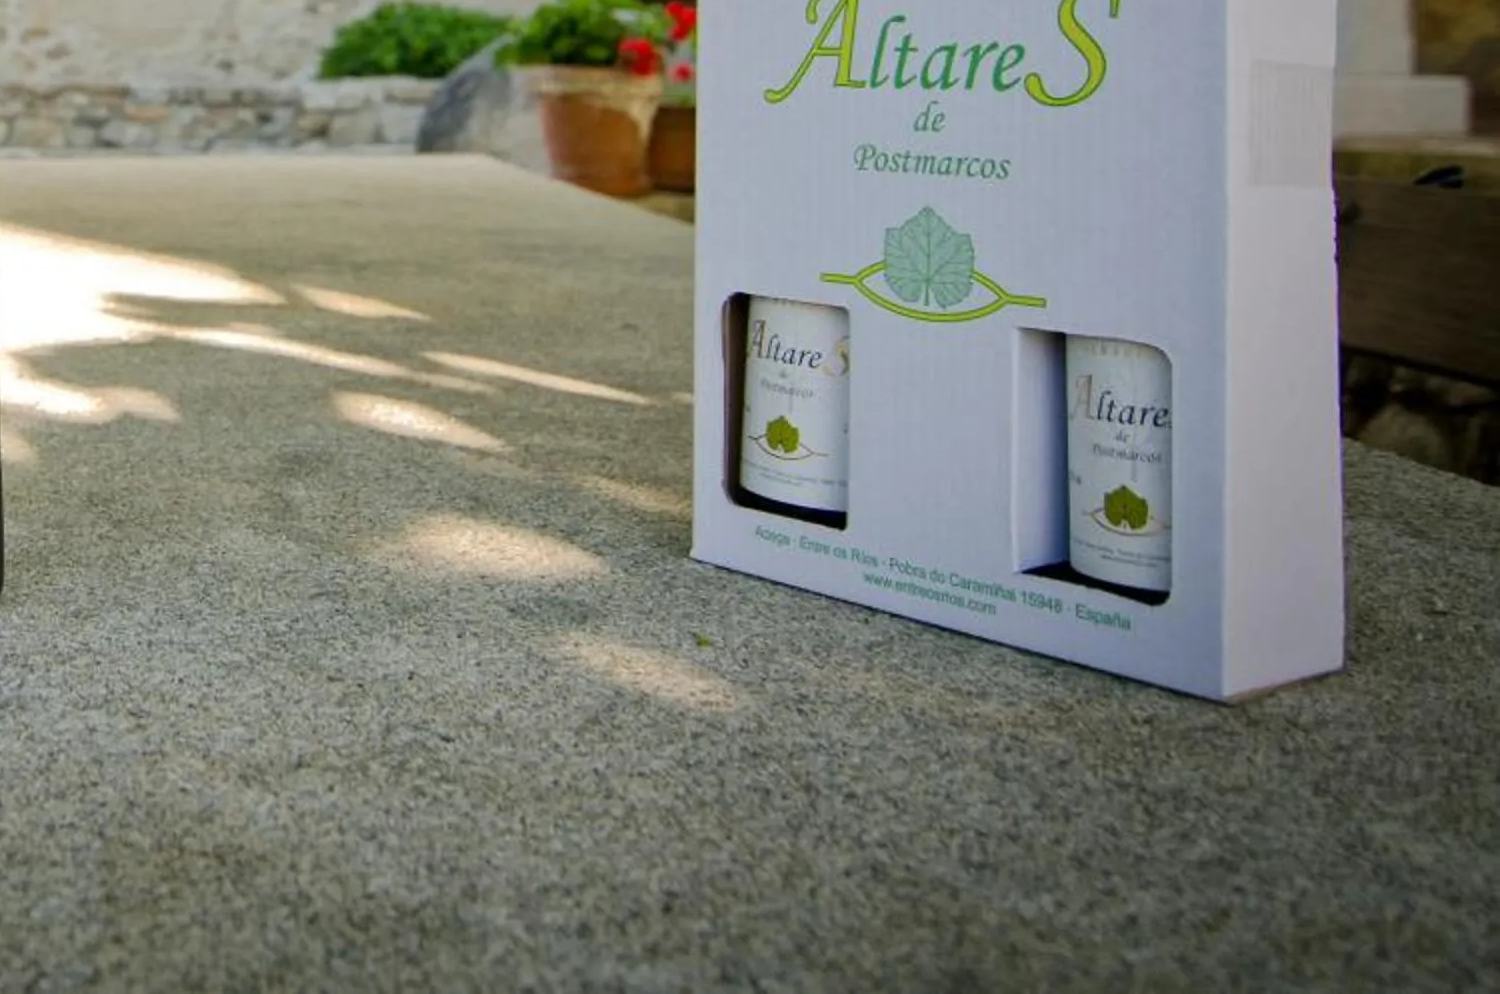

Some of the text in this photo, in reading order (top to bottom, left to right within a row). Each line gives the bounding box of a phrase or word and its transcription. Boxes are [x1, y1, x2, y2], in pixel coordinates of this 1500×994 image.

[913, 101, 946, 132] de
[853, 143, 1011, 180] Postmarcos
[889, 557, 927, 579] Pobra
[1075, 604, 1132, 631] España
